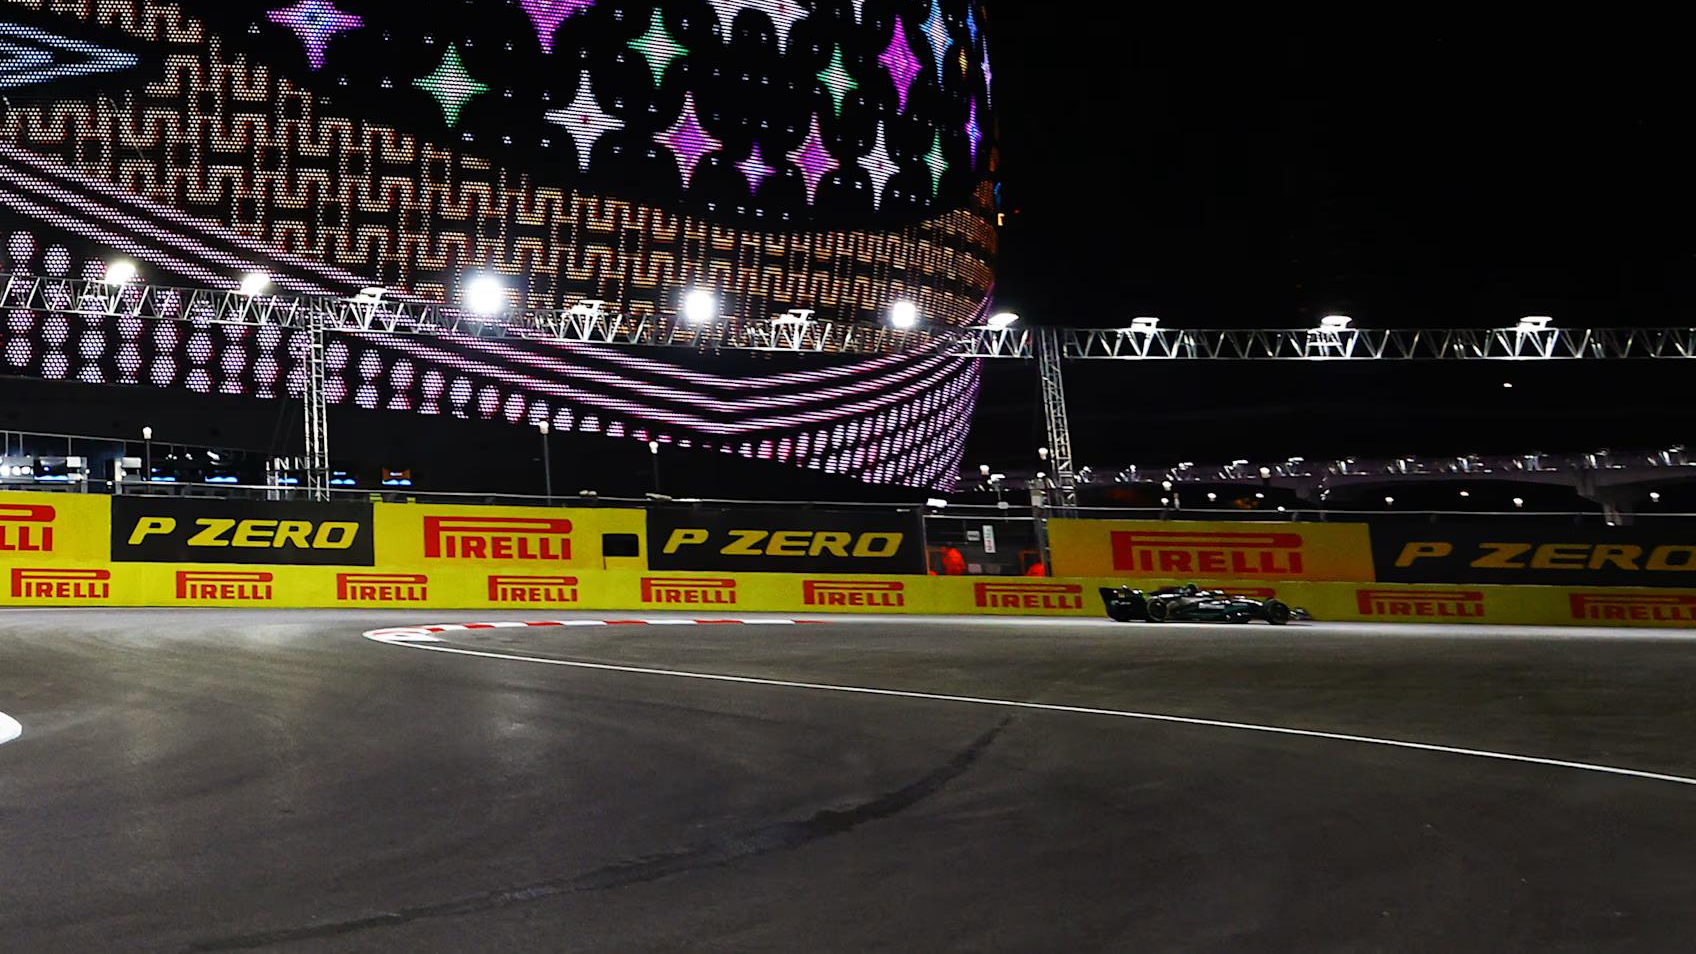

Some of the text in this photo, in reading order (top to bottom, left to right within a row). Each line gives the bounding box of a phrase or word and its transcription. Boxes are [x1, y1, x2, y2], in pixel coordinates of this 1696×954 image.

[128, 517, 360, 549] P ZERO
[424, 515, 573, 560] PIRELLI
[663, 528, 903, 557] P ZERO
[1110, 531, 1303, 574] PIRELLI
[1396, 542, 1696, 571] P ZERO
[11, 568, 110, 599] PIRELLI
[176, 571, 273, 600] PIRELLI
[337, 573, 428, 601] PIRELLI
[488, 575, 578, 602] PIRELLI
[641, 577, 737, 604] PIRELLI
[803, 579, 904, 607] PIRELLI
[974, 582, 1083, 610] PIRELLI
[1357, 589, 1484, 617] PIRELLI
